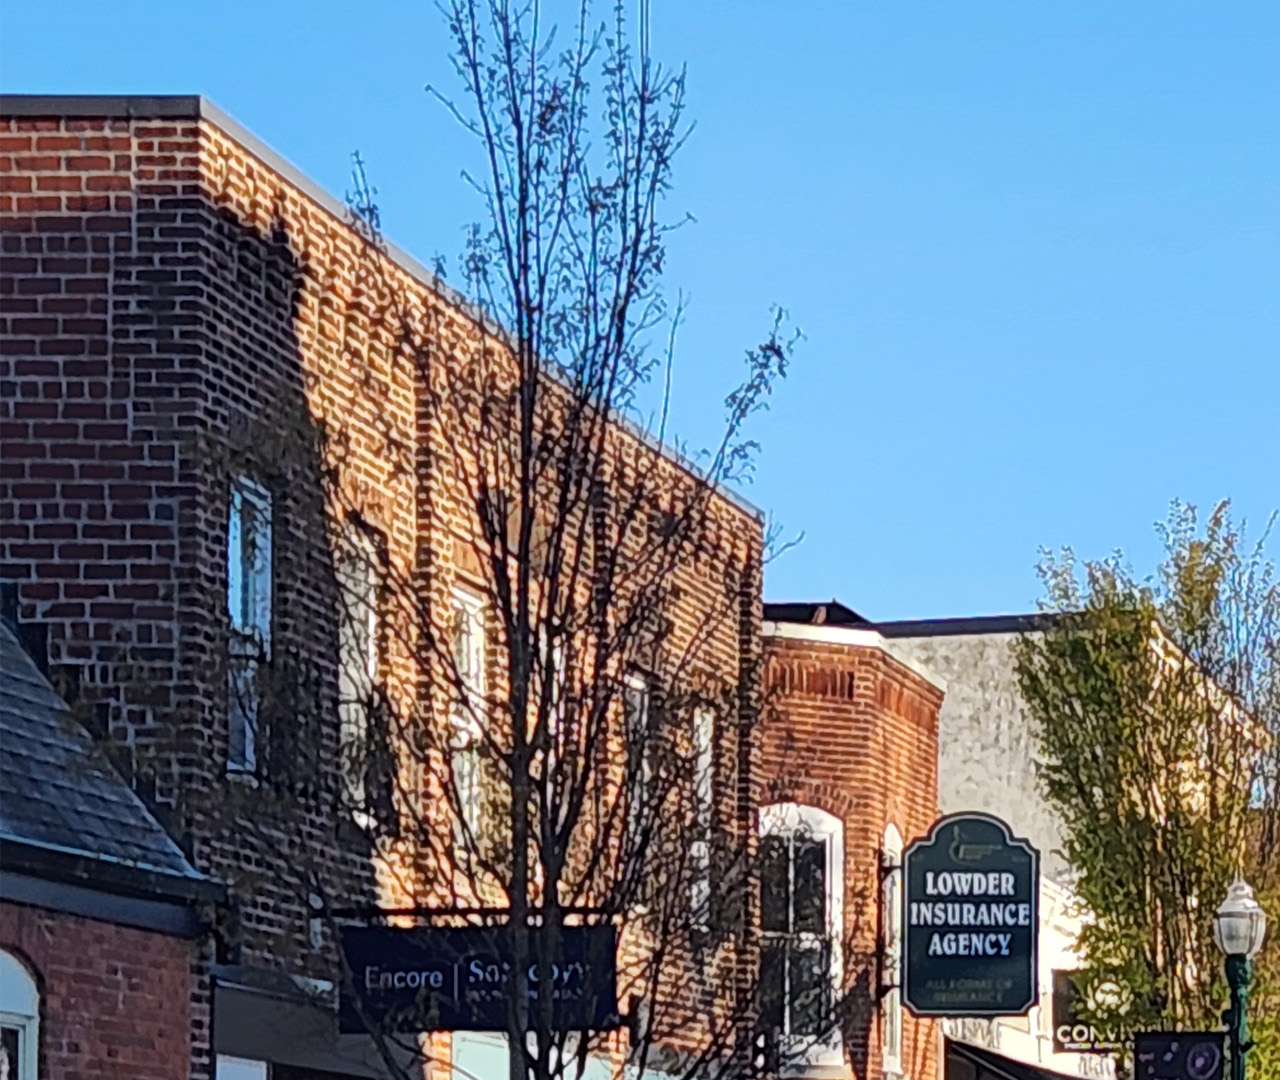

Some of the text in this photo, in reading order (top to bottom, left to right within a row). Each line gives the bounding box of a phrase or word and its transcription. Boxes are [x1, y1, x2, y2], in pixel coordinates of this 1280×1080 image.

[926, 871, 1015, 896] LOWDER
[910, 902, 1030, 926] INSURANCE
[928, 932, 1012, 956] AGENCY
[365, 965, 443, 988] Encore
